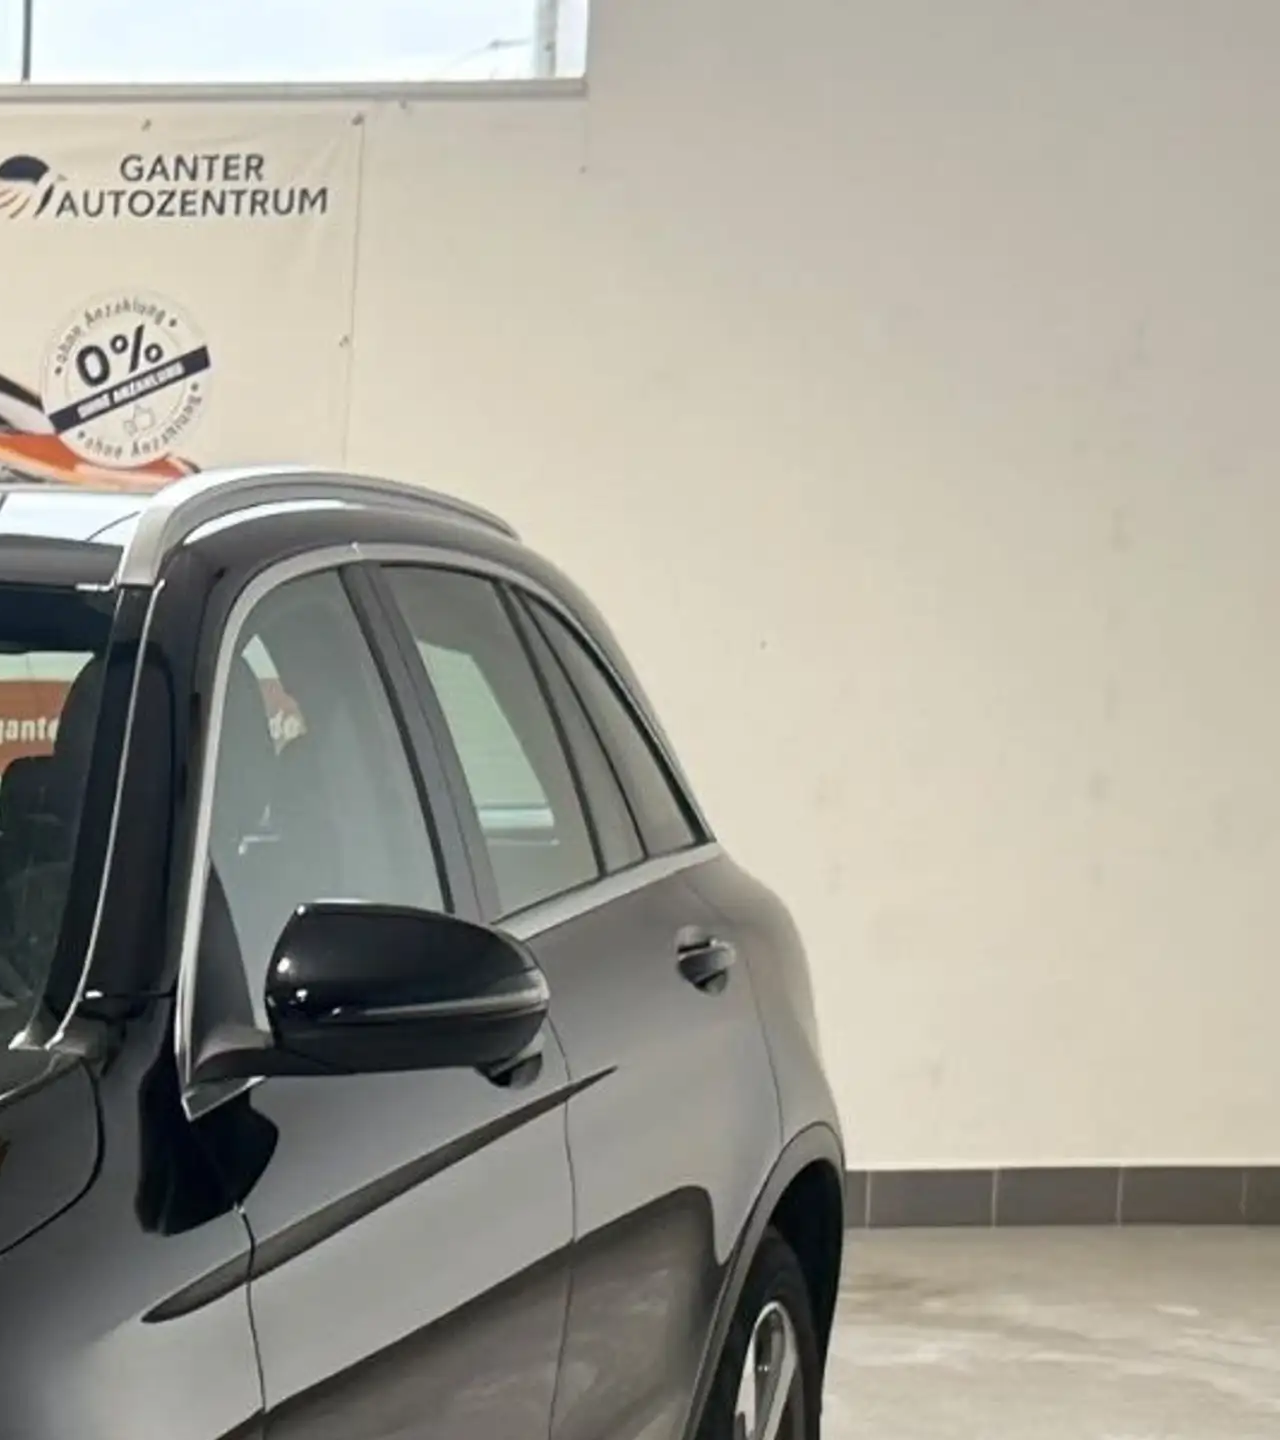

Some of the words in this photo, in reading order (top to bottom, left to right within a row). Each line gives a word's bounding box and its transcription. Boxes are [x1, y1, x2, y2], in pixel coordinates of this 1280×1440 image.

[120, 153, 265, 182] GANTER
[55, 187, 329, 219] AUTOZENTRUM
[75, 323, 164, 387] 0%
